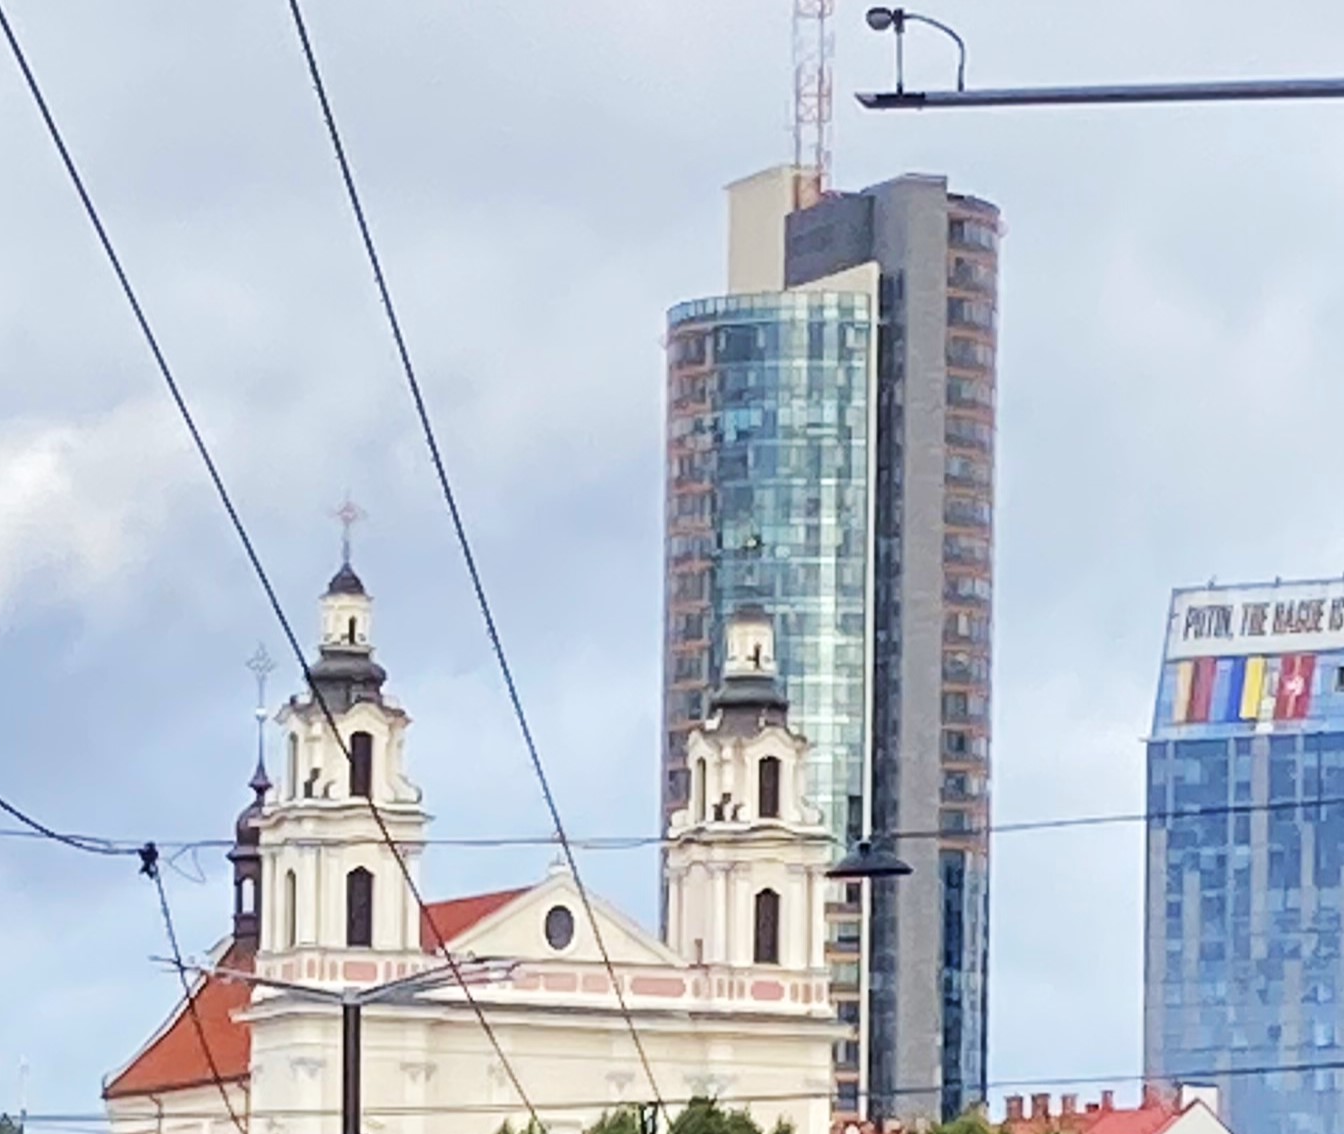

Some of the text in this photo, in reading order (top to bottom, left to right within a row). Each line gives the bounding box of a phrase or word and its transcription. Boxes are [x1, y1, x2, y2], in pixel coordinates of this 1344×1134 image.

[1183, 604, 1234, 641] PUTIN,
[1240, 601, 1271, 636] THE
[1271, 598, 1327, 634] HAGUE
